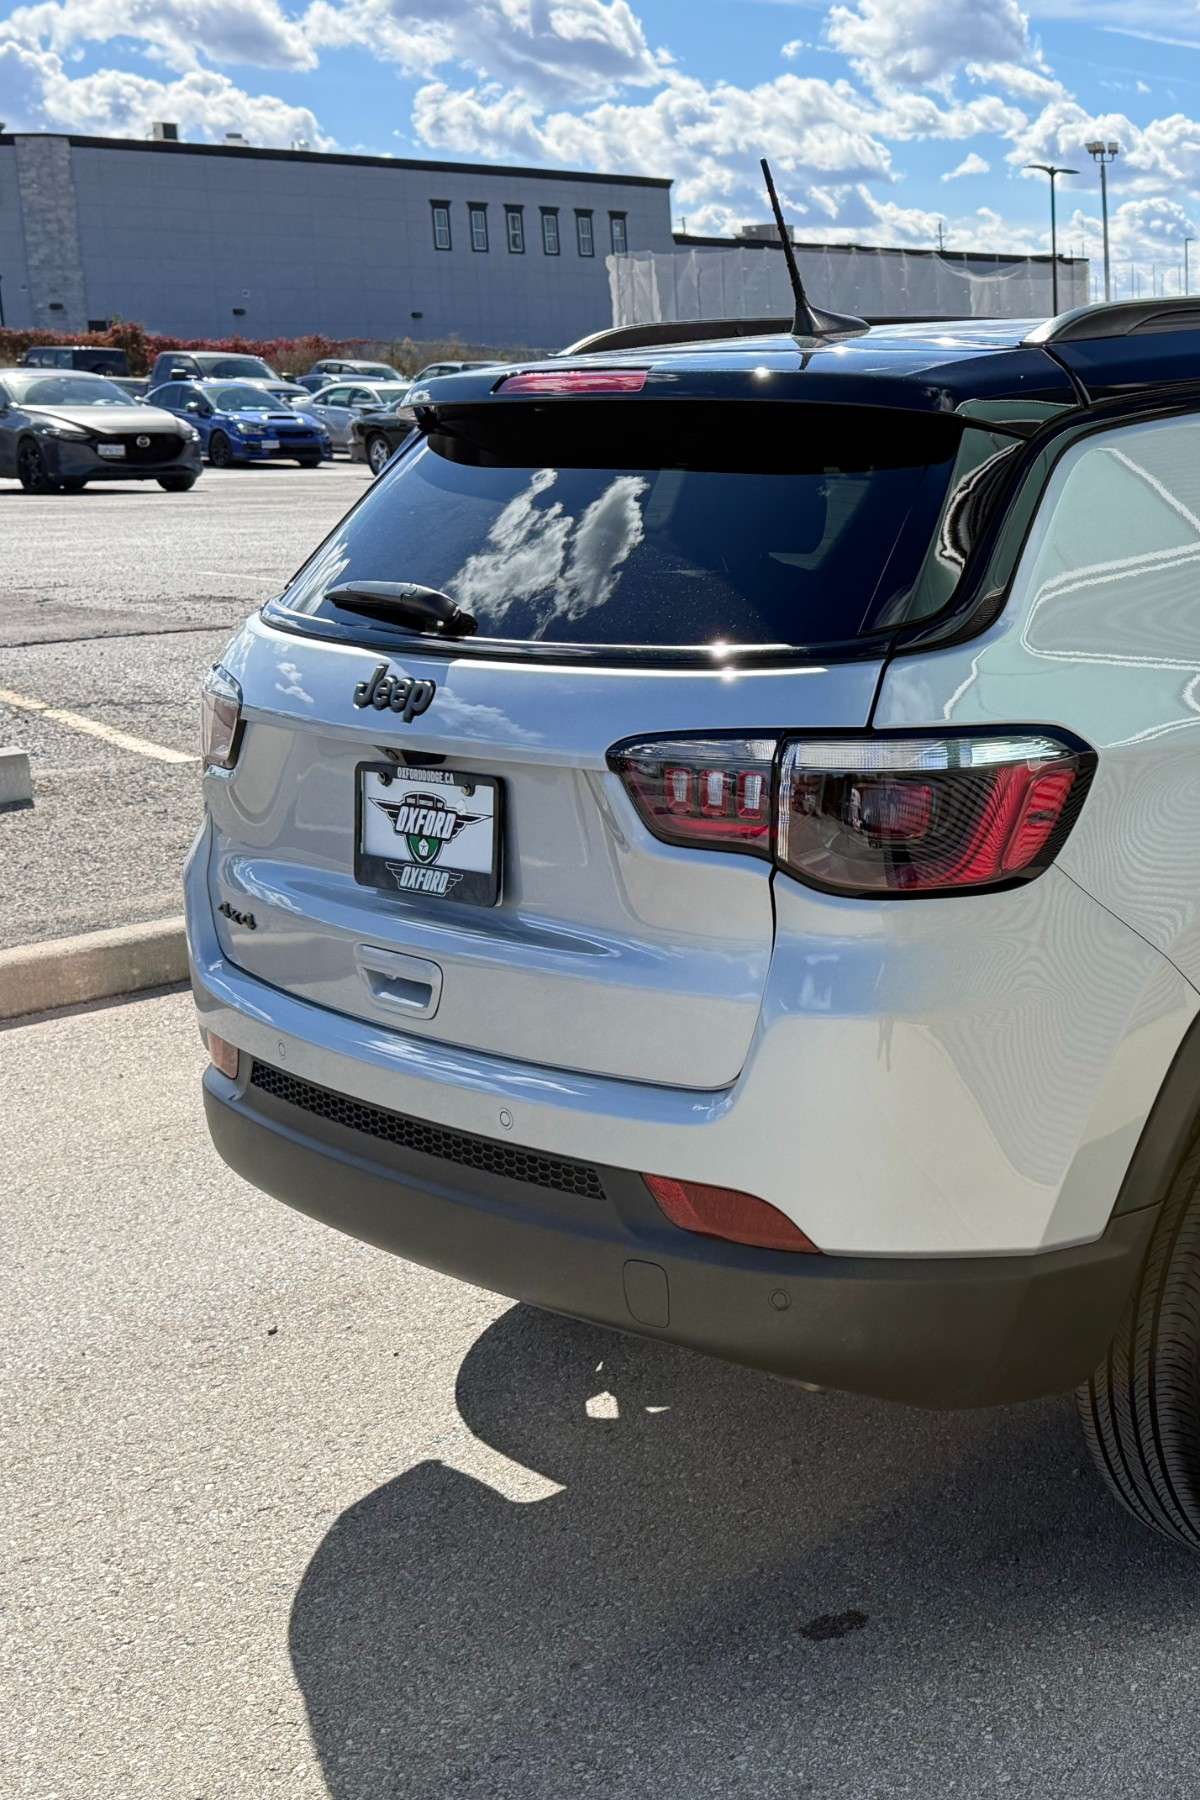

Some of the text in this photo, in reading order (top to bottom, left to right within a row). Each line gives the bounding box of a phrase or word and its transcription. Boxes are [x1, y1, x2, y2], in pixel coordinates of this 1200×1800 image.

[353, 663, 436, 724] Jeep
[397, 767, 454, 784] OXFORDDODGE.CA
[396, 806, 456, 839] OXFORD
[400, 866, 449, 893] OXFORD
